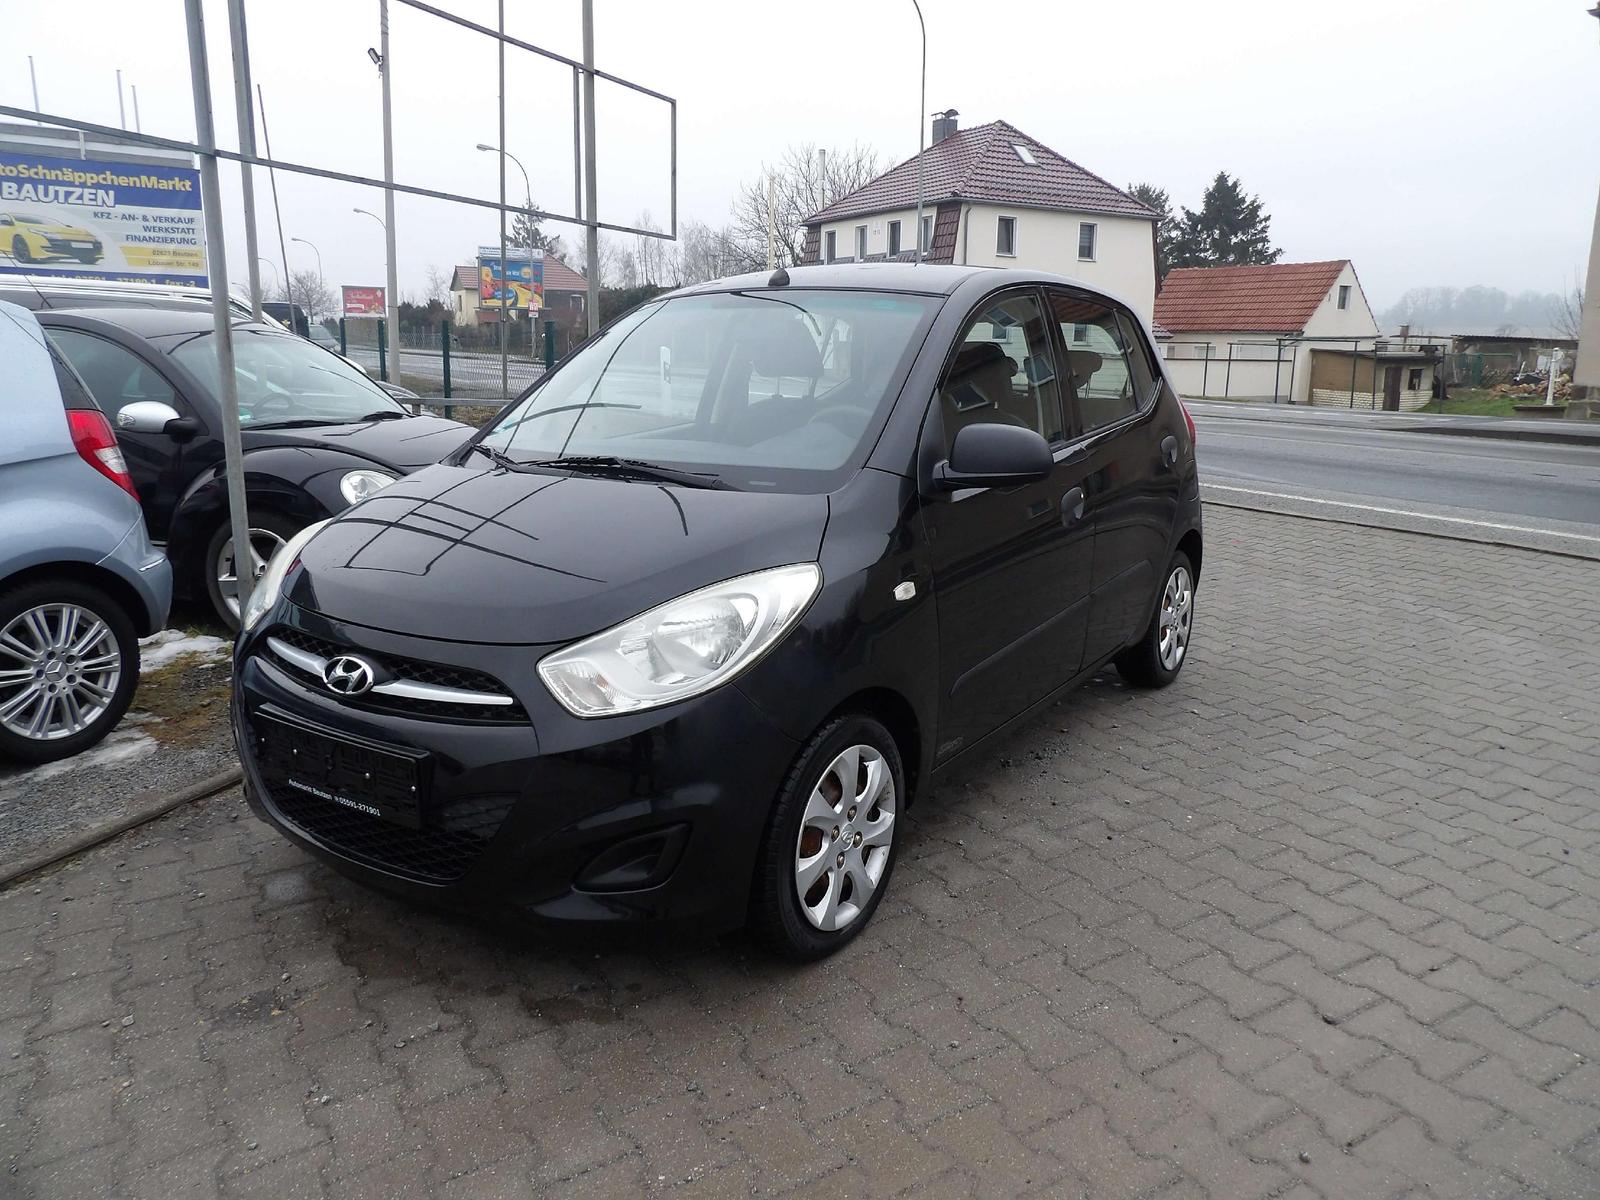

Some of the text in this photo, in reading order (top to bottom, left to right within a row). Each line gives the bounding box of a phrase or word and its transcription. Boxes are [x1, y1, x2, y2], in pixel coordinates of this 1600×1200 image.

[1, 181, 116, 208] BAUTZEN
[93, 211, 112, 220] KFZ
[142, 215, 150, 223] &
[152, 216, 196, 225] VERKAUF
[142, 225, 196, 235] WERKSTATT
[125, 234, 197, 246] FINANZIERUNG
